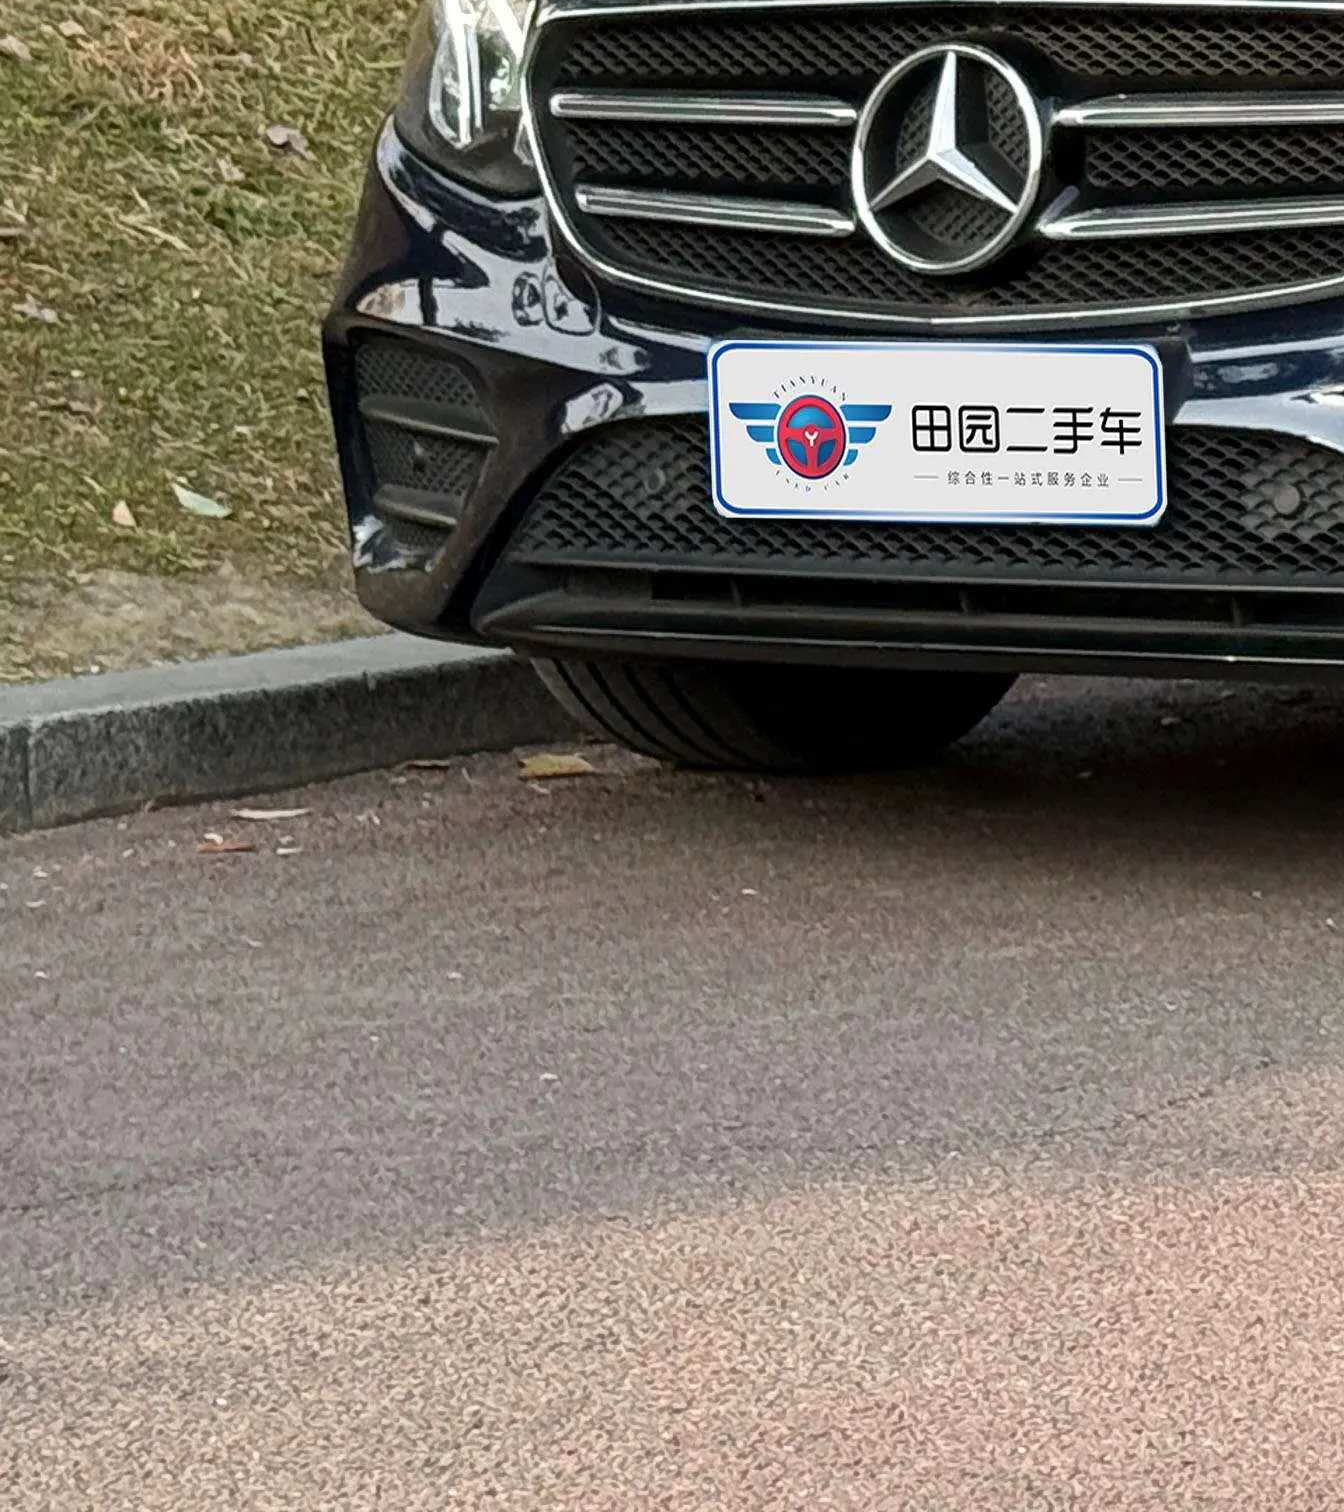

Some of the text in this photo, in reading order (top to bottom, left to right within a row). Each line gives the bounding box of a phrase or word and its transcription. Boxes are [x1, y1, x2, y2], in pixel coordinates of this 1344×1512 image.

[911, 405, 1143, 455] 田园二手车
[947, 470, 1109, 488] 综合性一站式服务企业
